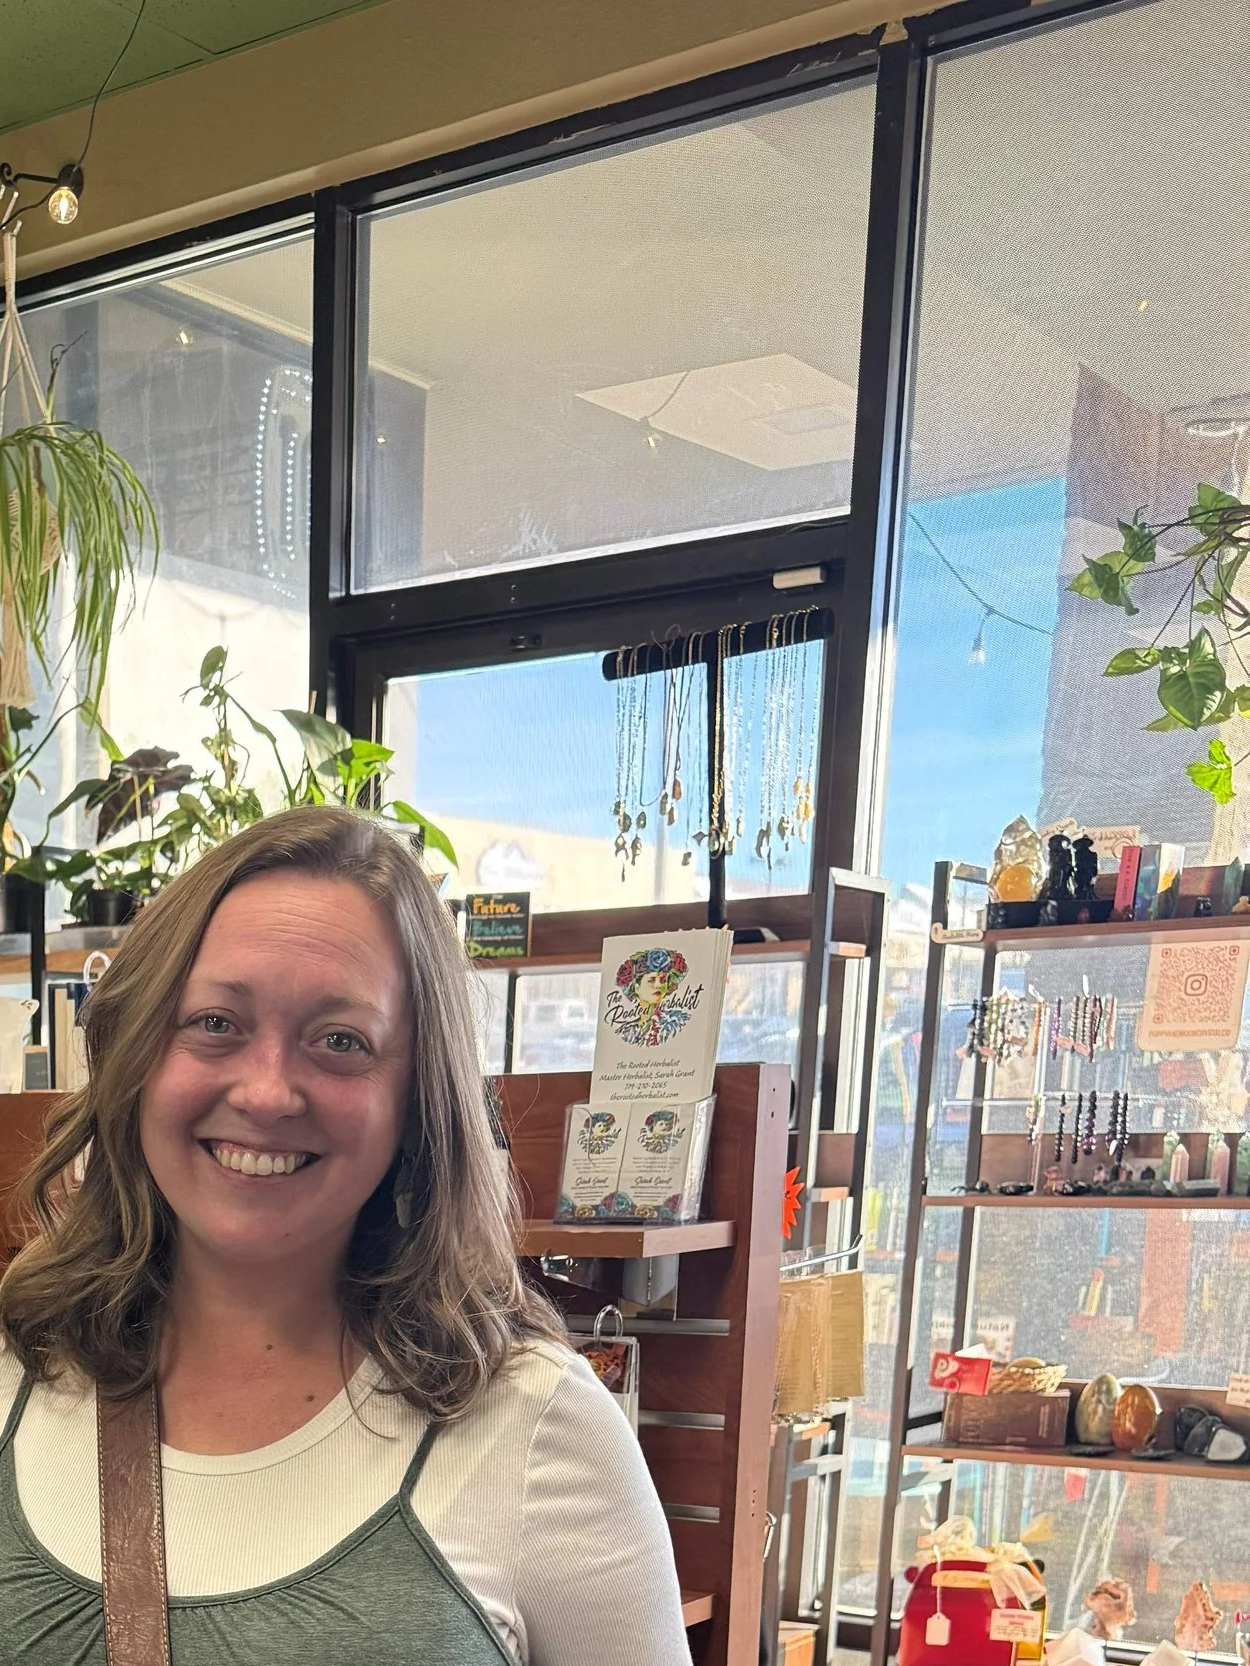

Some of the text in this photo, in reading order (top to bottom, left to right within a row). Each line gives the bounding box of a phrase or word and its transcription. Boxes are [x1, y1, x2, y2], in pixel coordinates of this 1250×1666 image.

[472, 897, 521, 914] Future
[607, 990, 623, 1008] The
[604, 1005, 650, 1028] Rooted
[616, 1058, 681, 1070] The Rooted Herbalist
[599, 1073, 622, 1081] Master
[654, 1069, 674, 1079] Sarah
[675, 1069, 696, 1078] Grant
